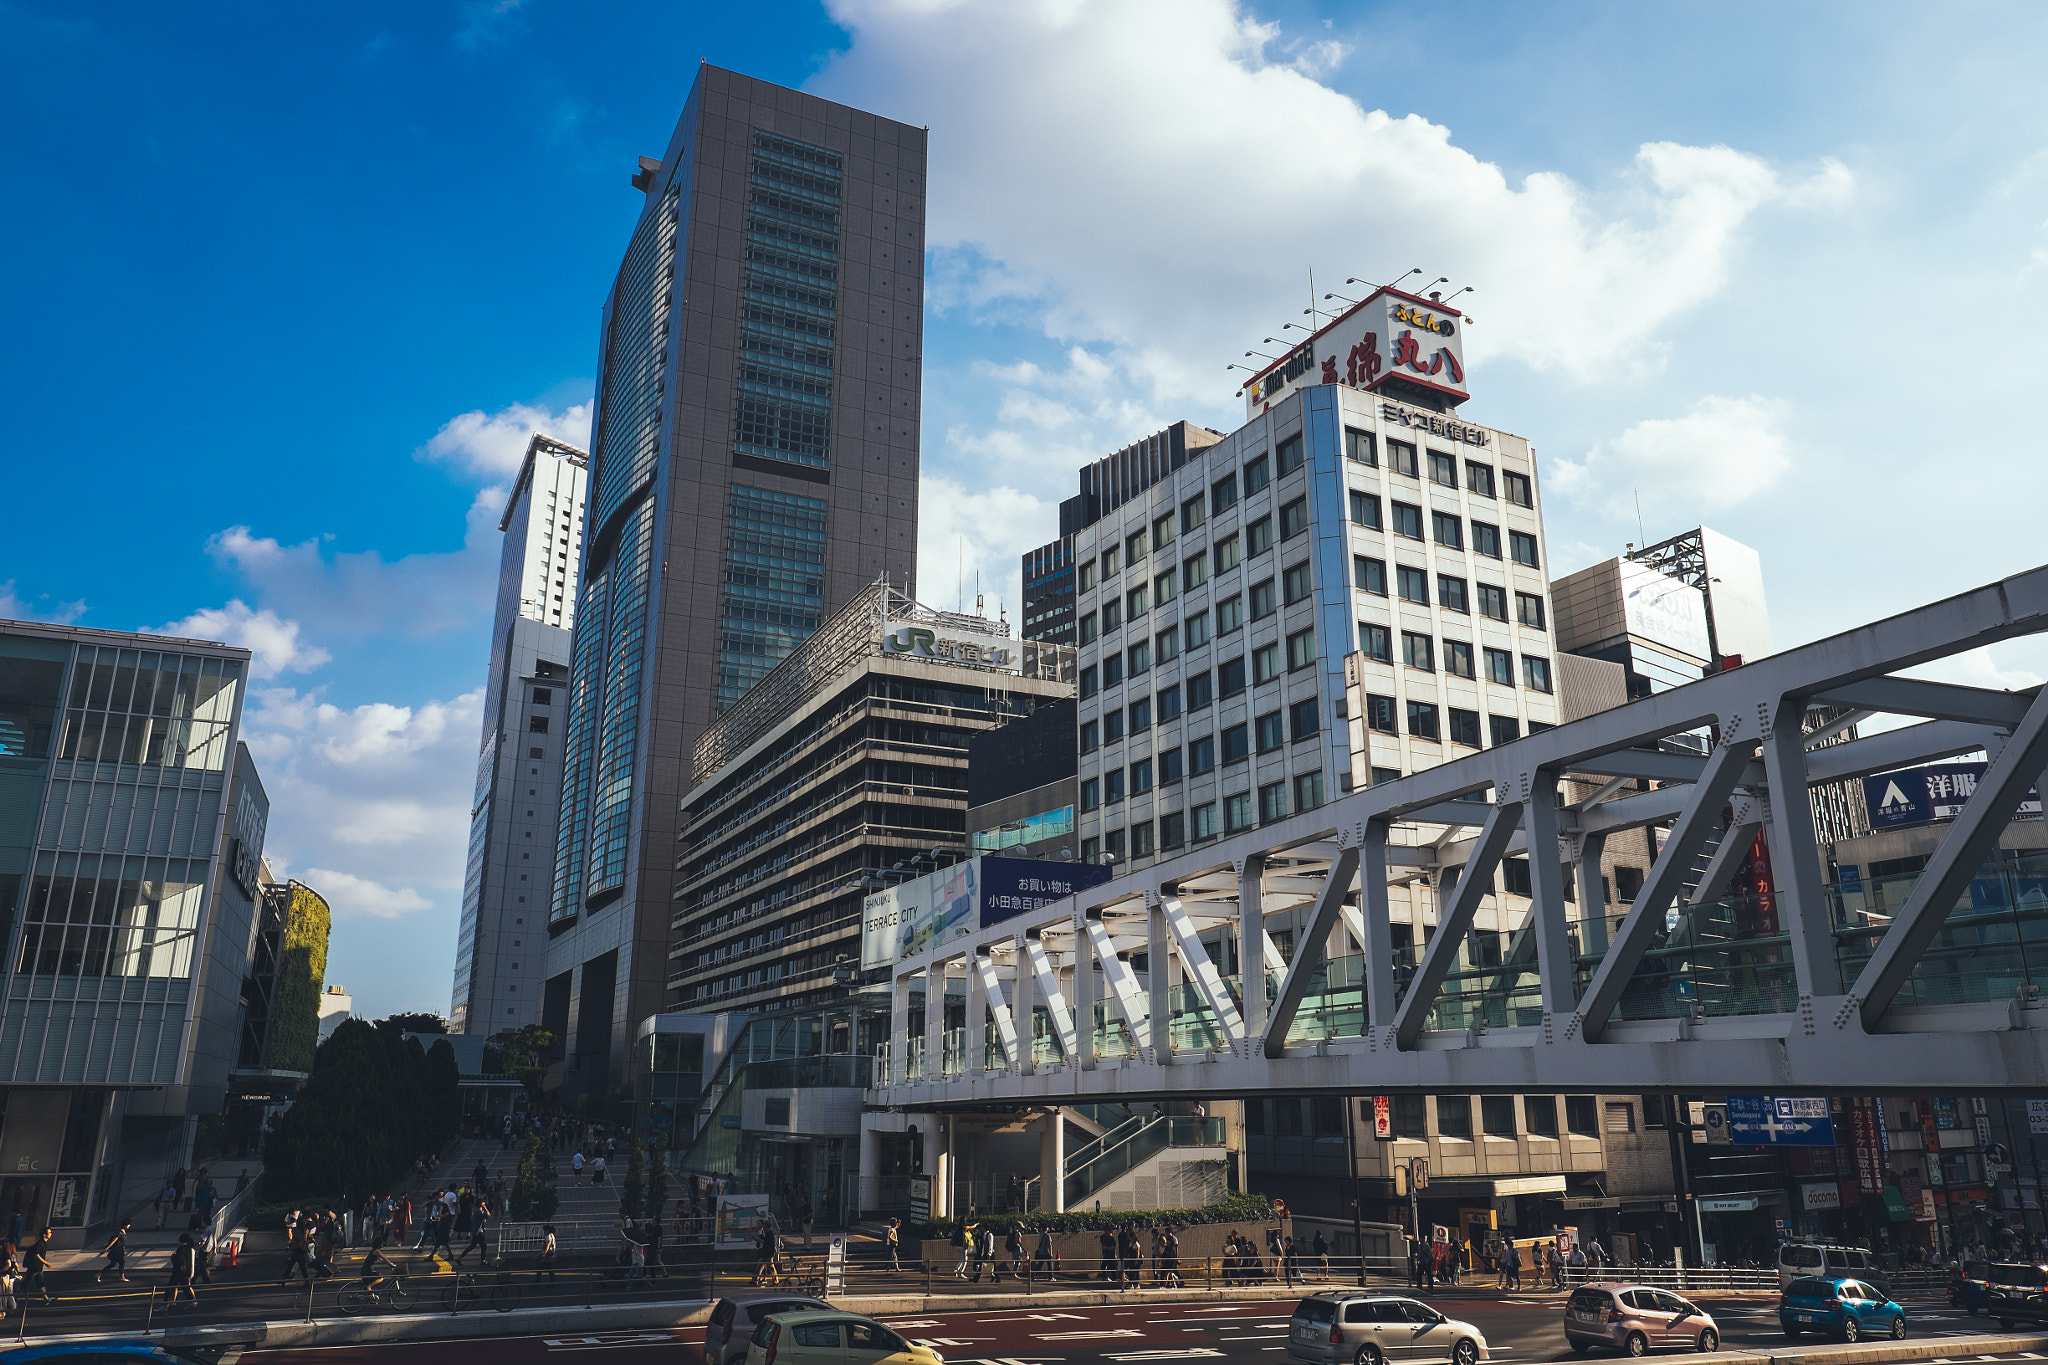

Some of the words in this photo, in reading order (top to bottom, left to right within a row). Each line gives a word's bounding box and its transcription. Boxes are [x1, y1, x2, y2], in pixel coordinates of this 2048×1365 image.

[1396, 303, 1455, 337] ふとんの
[1394, 329, 1463, 383] 丸八
[1383, 403, 1491, 446] ミヤコ新宿ビル
[890, 627, 936, 656] JR
[938, 638, 1018, 666] 新宿ビル
[866, 893, 891, 910] SHINJUKU
[1018, 878, 1072, 894] お買い物は
[865, 912, 898, 933] TERRACE
[901, 905, 919, 923] CITY
[1763, 1102, 1773, 1111] 20
[1876, 1097, 1889, 1152] EXCHANGE
[1808, 1192, 1837, 1204] docomo
